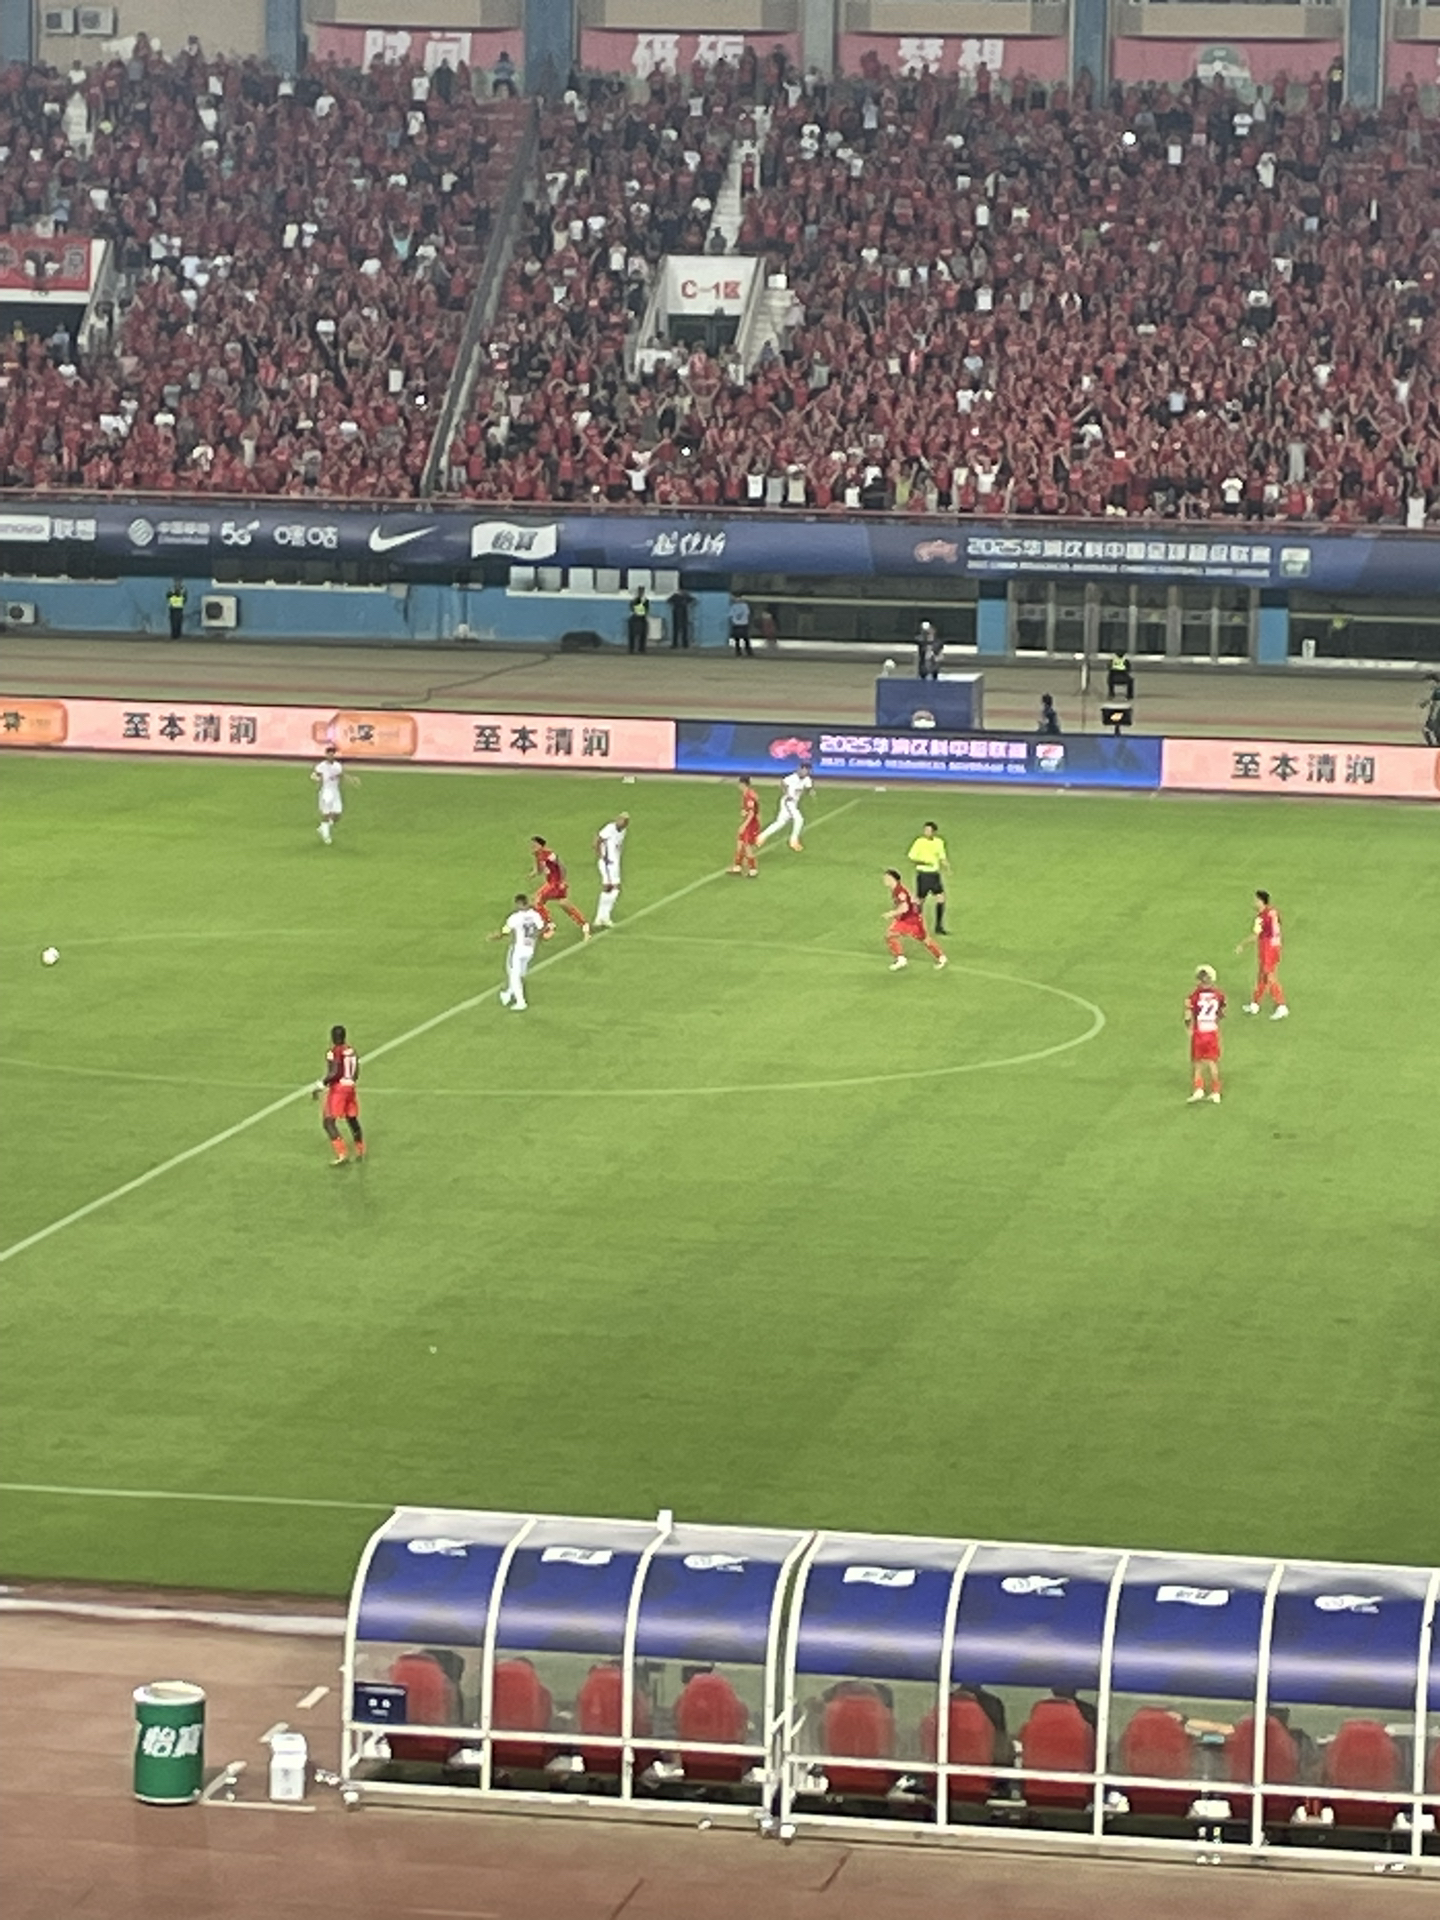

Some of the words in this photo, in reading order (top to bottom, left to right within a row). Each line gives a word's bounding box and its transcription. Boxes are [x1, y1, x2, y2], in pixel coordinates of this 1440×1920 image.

[681, 280, 741, 299] C-1区
[122, 711, 257, 744] 至本清润
[472, 724, 610, 757] 至本清润
[1231, 752, 1375, 784] 至本清润
